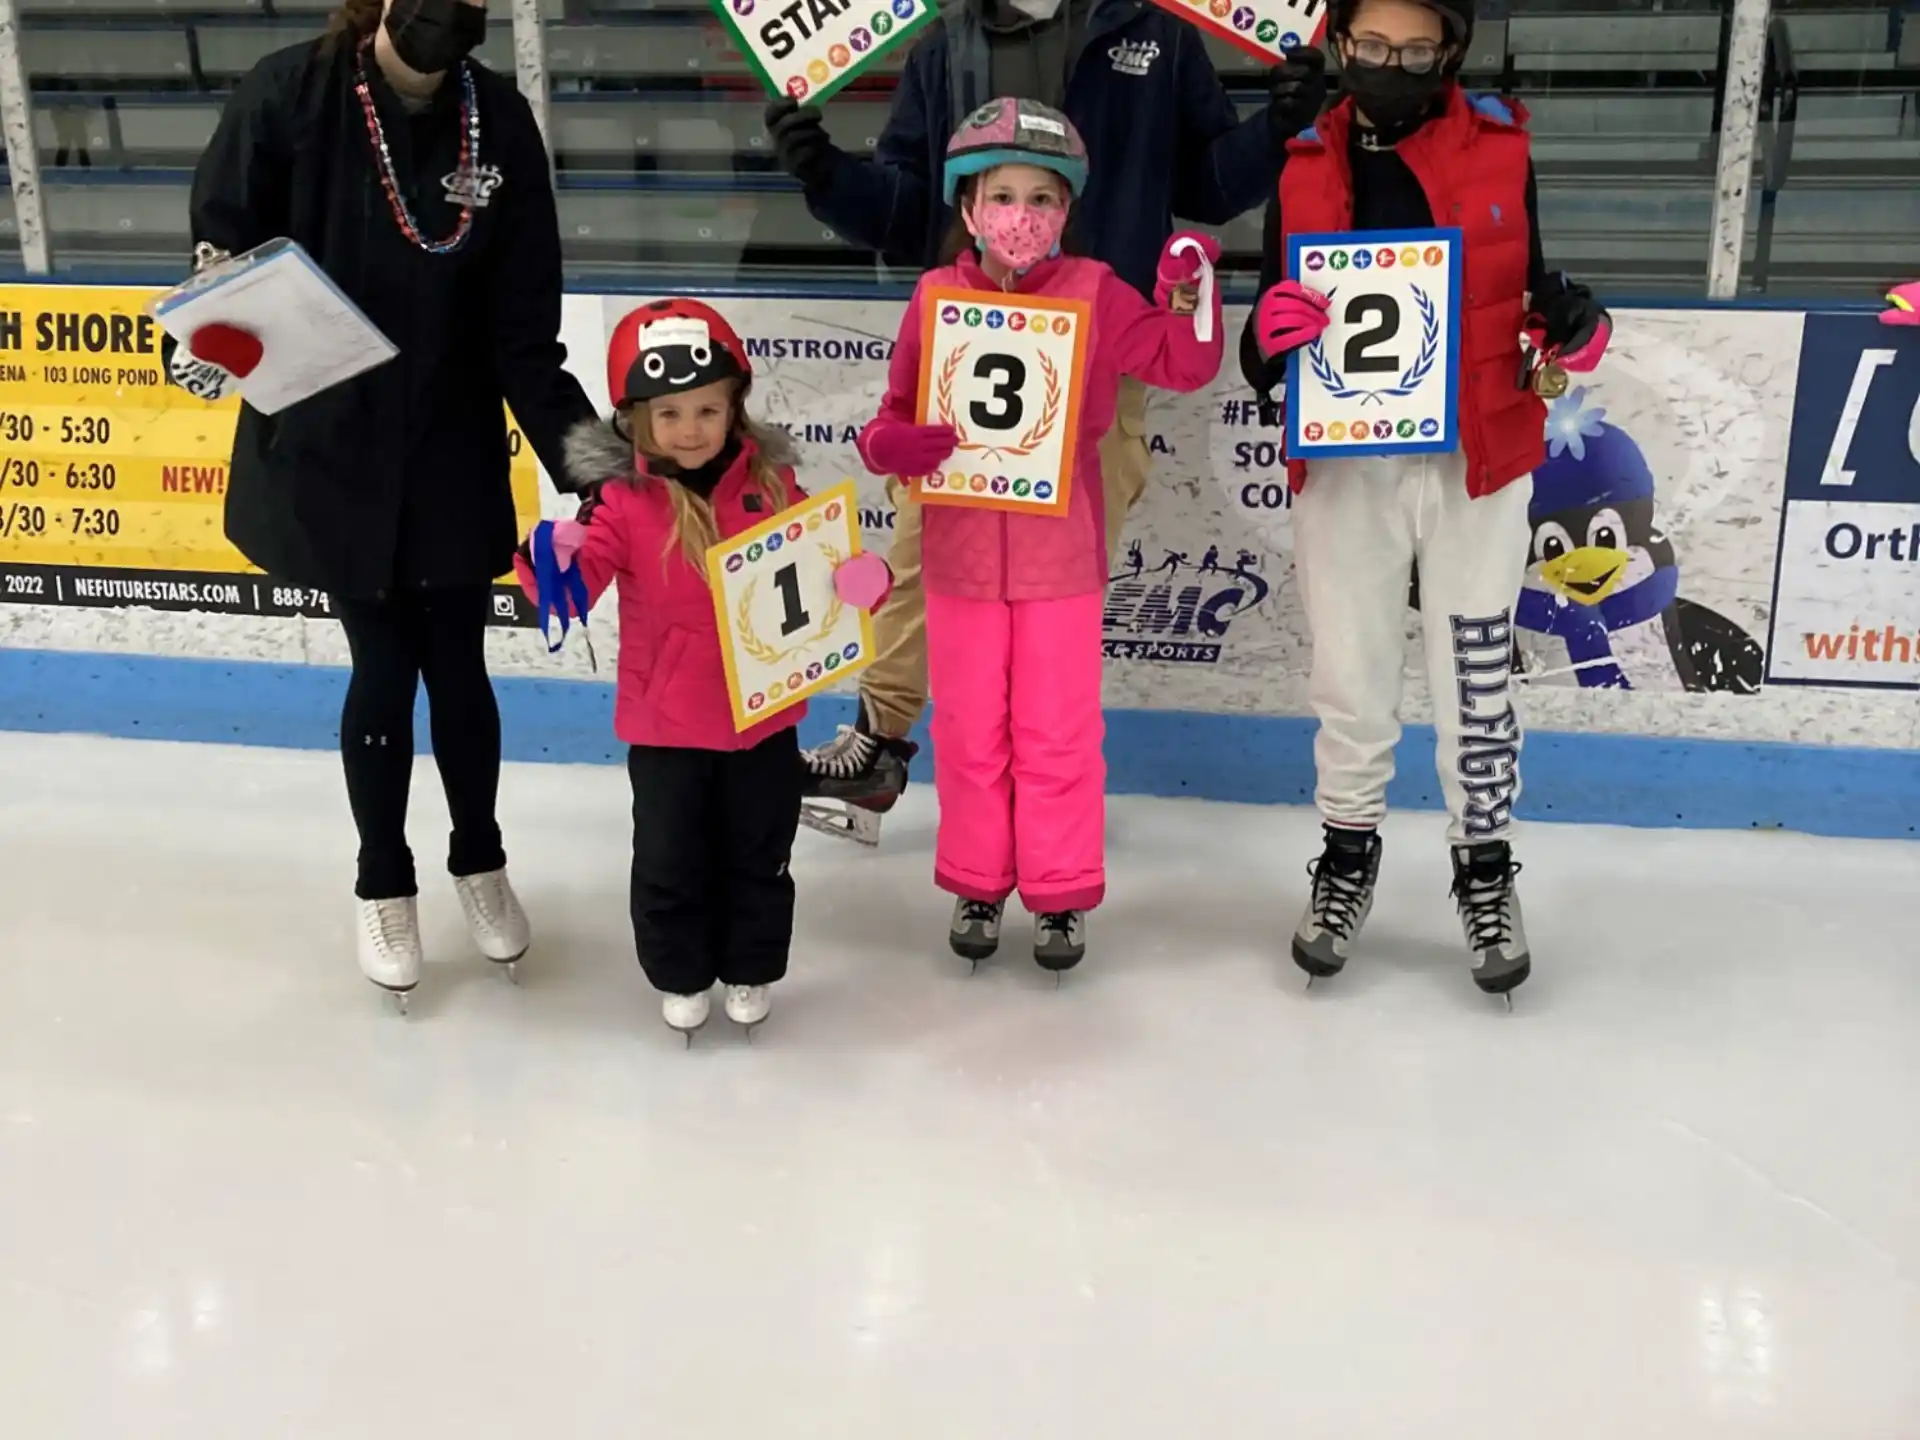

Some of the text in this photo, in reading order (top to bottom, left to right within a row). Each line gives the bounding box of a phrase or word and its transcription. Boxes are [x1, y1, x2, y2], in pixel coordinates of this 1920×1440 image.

[760, 0, 852, 59] STA
[36, 312, 153, 353] SHORE
[1344, 294, 1400, 373] 2
[44, 367, 67, 383] 103
[73, 368, 111, 384] LONG
[117, 370, 158, 386] POND
[970, 353, 1026, 430] 3
[61, 416, 110, 444] 5:30
[66, 463, 116, 490] 6:30
[162, 465, 224, 494] NEW!
[72, 508, 120, 535] 7:30
[5, 575, 44, 594] 2022
[75, 578, 241, 604] NEFUTURESTARS.COM
[774, 562, 810, 637] 1
[1133, 643, 1216, 661] SPORTS
